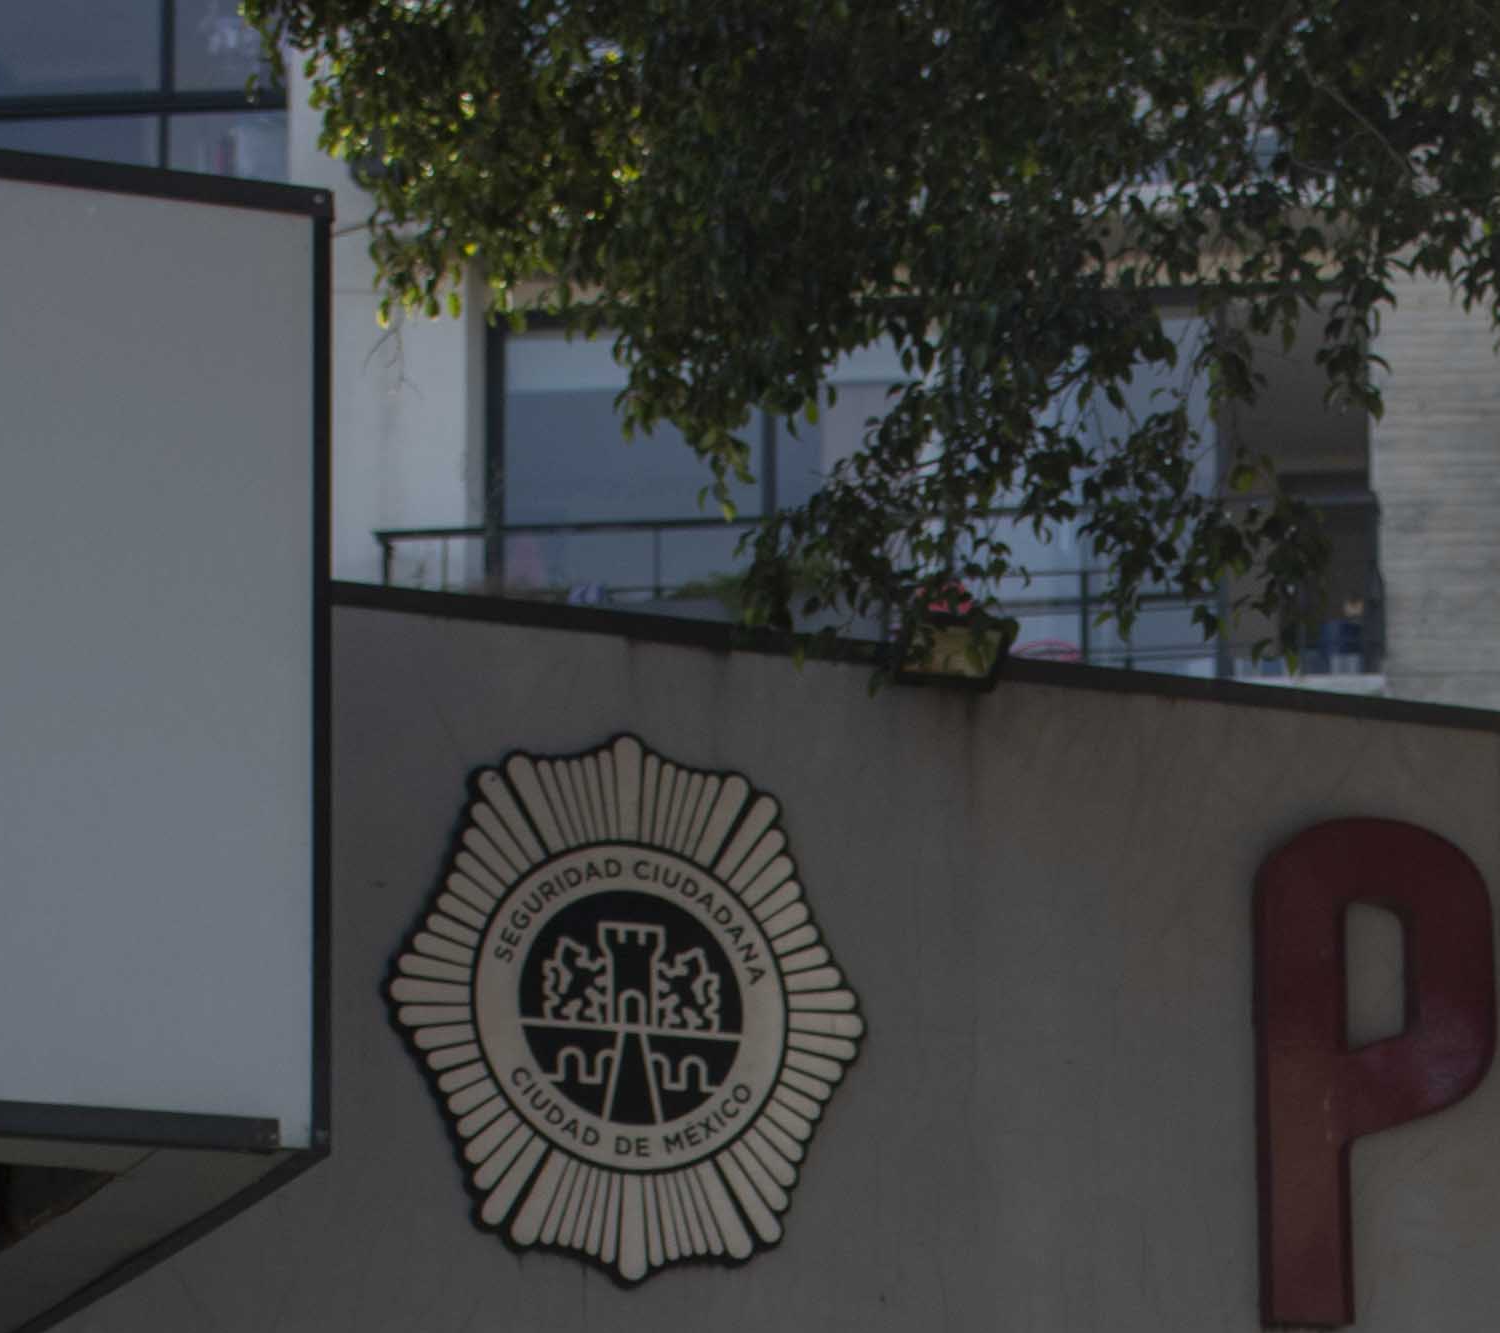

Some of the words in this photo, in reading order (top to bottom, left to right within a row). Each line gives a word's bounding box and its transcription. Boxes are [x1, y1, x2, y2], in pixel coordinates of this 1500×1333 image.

[494, 857, 624, 964] SEGURIDAD
[632, 859, 766, 987] CIUDADANA
[510, 1065, 601, 1147] CIUDAD
[614, 1135, 652, 1157] DE
[665, 1082, 753, 1156] MÉXICO
